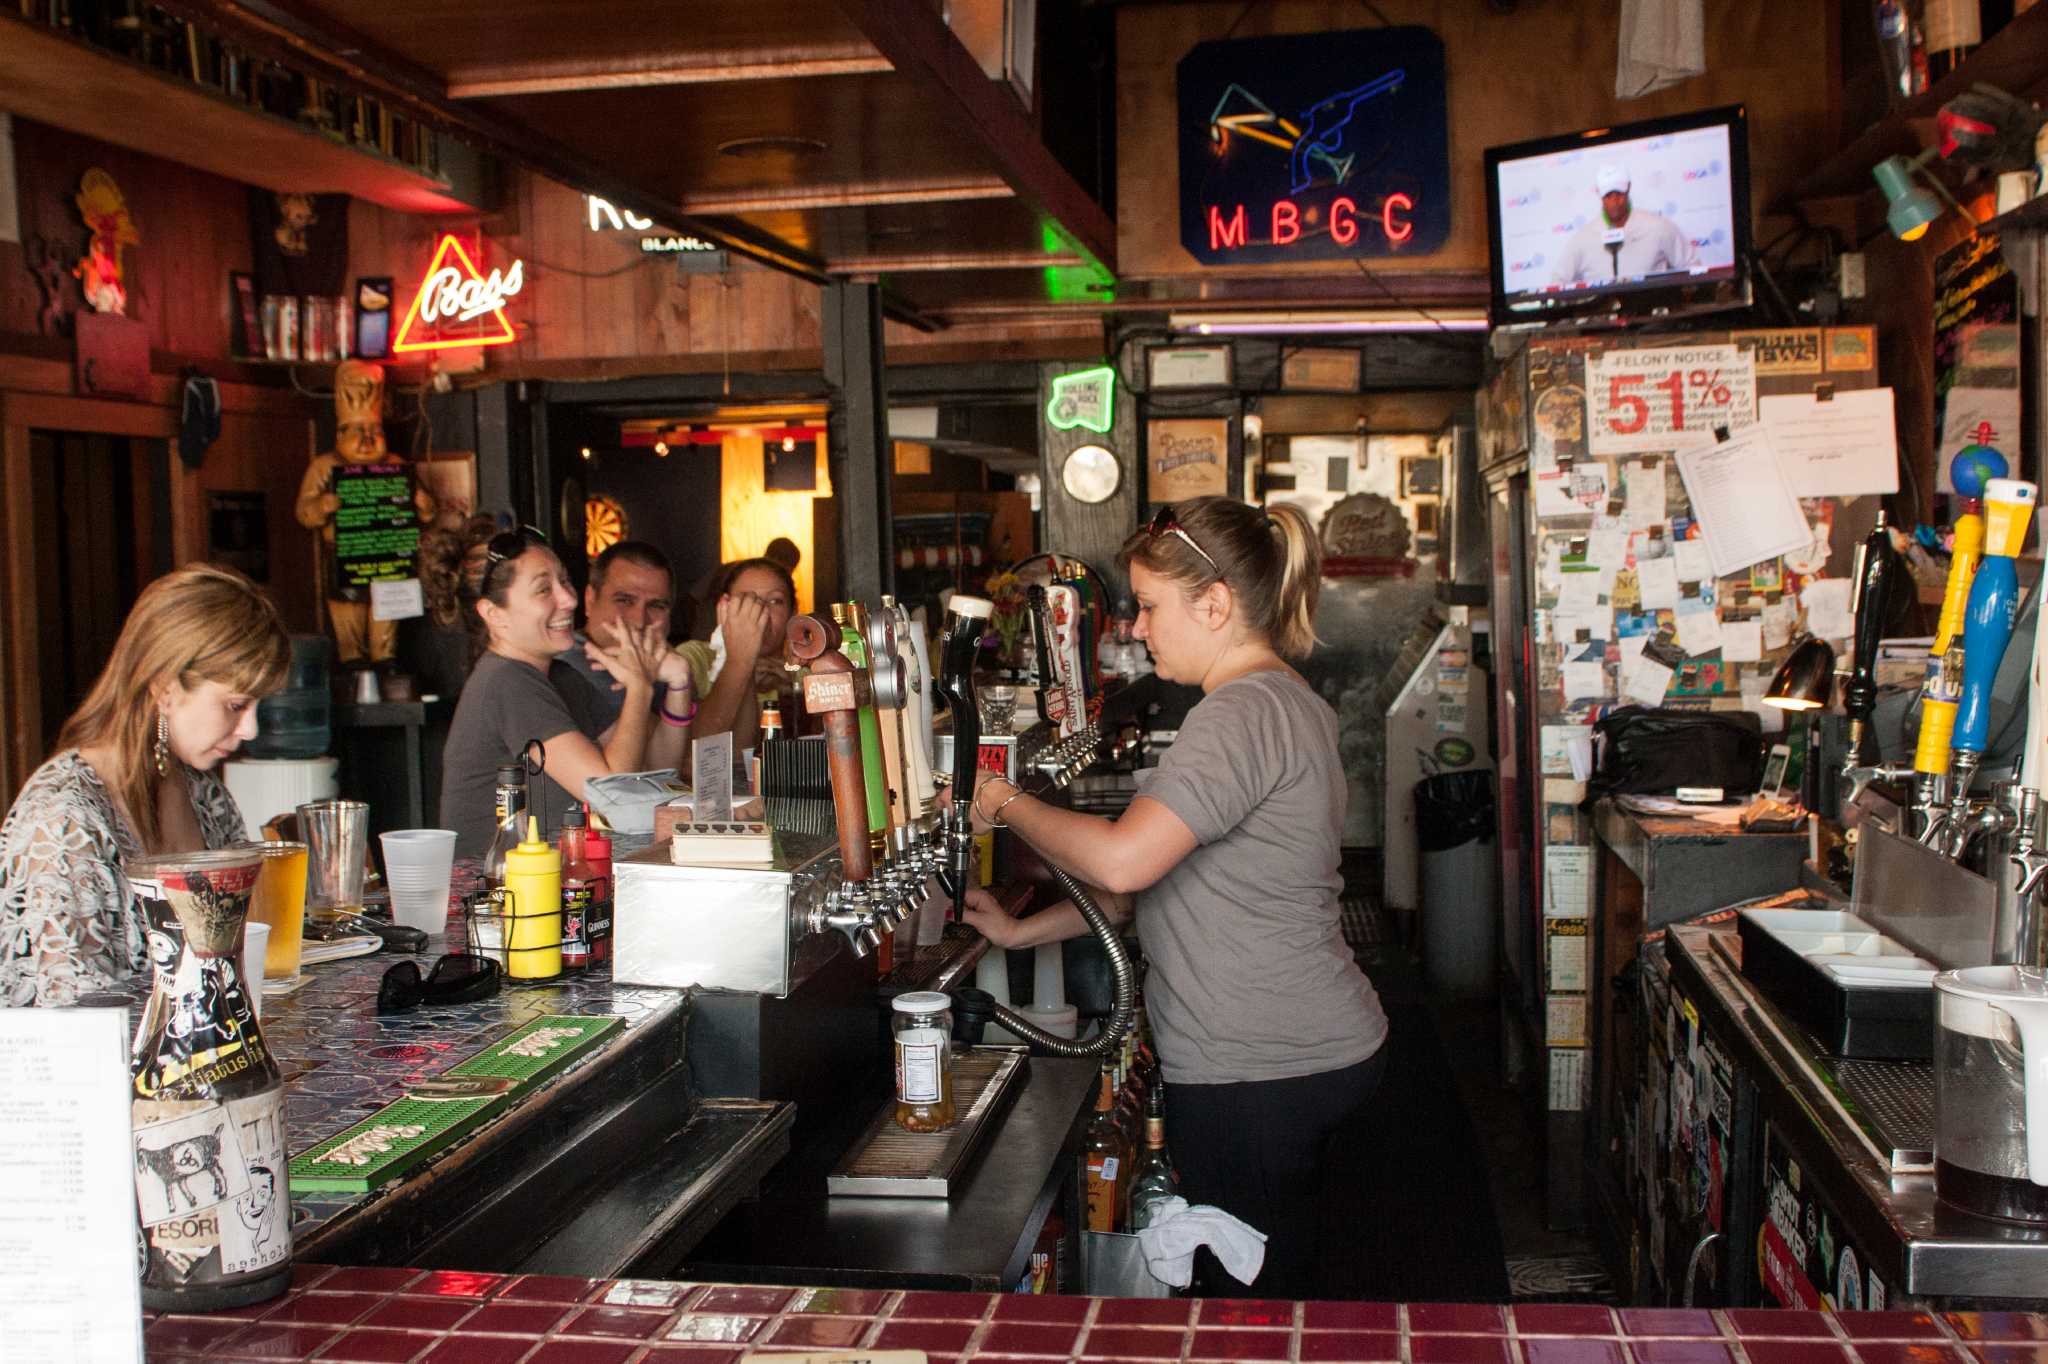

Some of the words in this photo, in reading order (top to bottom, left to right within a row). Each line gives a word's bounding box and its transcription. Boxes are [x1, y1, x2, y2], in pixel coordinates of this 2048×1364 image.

[421, 259, 523, 322] Bass
[1615, 353, 1671, 367] FELONY
[1674, 351, 1723, 364] NOTICE
[1607, 369, 1732, 436] 51%
[808, 681, 851, 702] Shiner
[587, 919, 610, 933] GUINNESS
